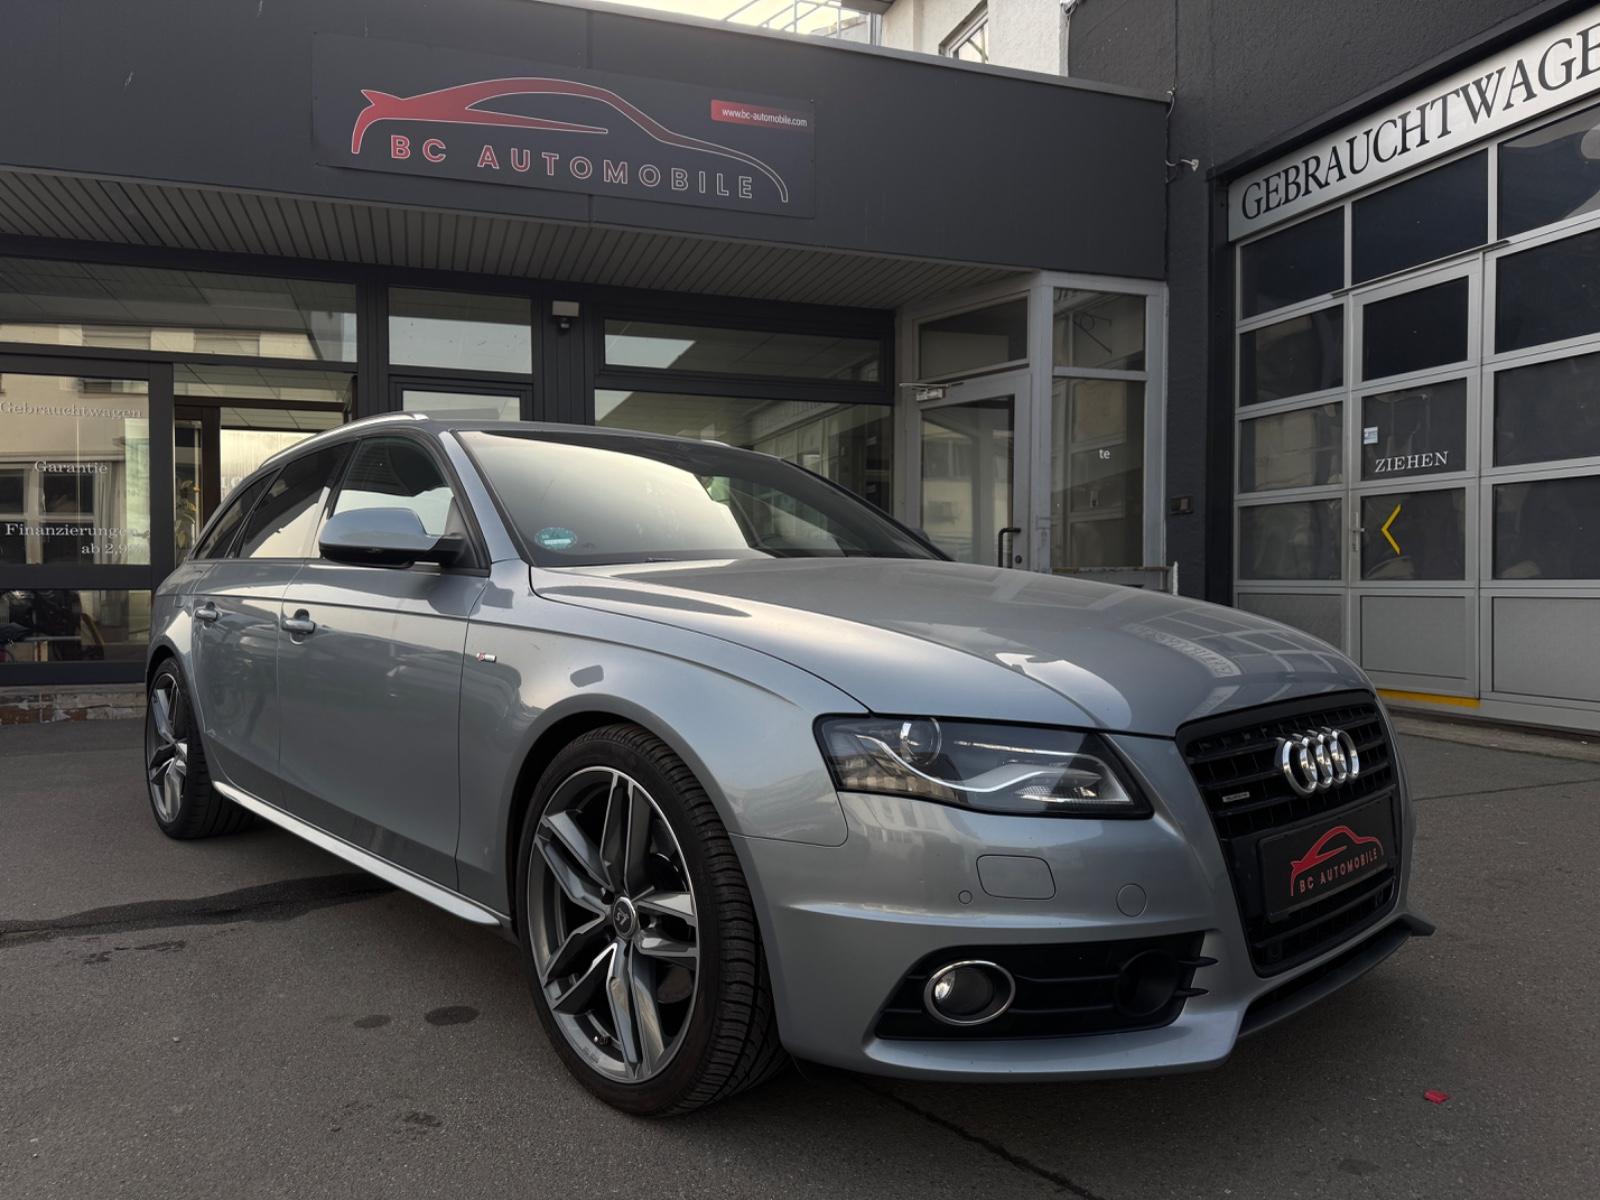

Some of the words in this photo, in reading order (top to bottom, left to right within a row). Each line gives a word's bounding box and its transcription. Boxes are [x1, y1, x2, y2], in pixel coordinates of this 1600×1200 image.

[721, 107, 808, 127] www.bc-automobile.com
[390, 134, 447, 162] BC
[476, 144, 754, 200] AUTOMOBILE
[0, 402, 142, 420] Gebrauchtwagen
[34, 460, 108, 475] Garantie
[1374, 450, 1449, 473] ZIEHEN
[81, 542, 100, 555] ab
[1299, 876, 1314, 894] BC
[1320, 847, 1378, 884] AUTOMOBILE
